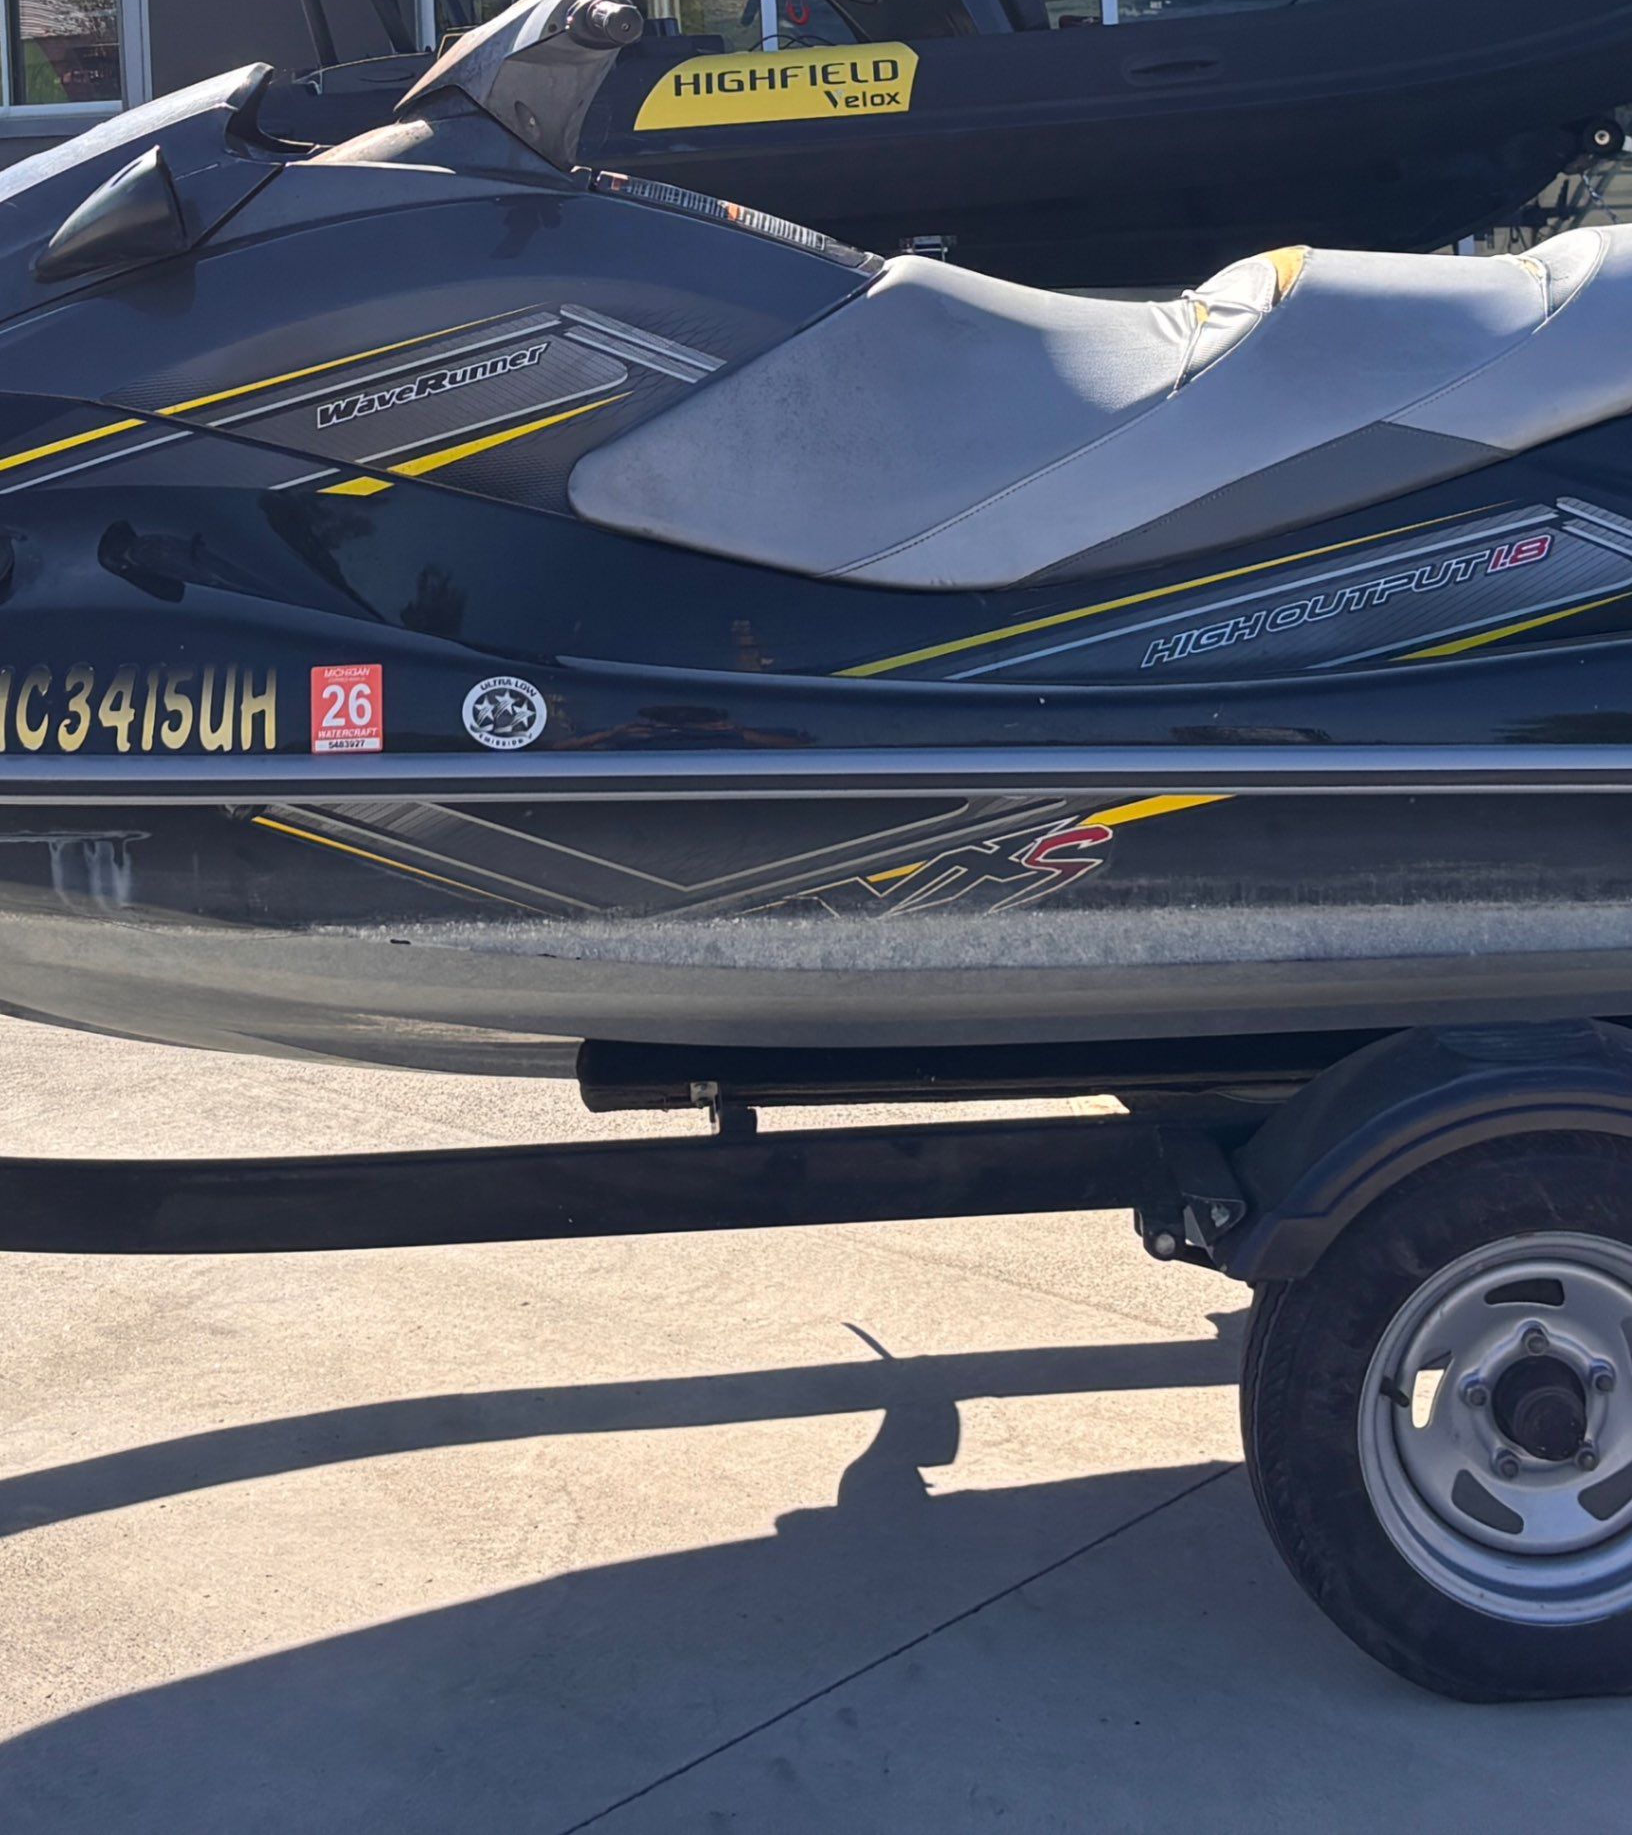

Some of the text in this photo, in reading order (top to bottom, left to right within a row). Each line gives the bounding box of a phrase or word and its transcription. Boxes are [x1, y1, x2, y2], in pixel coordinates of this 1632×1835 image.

[673, 58, 900, 97] HIGHFIELD
[823, 90, 901, 109] Velox
[318, 342, 550, 429] WaveRunner
[1141, 533, 1555, 669] HIGH OUTPUT 1.8
[321, 683, 373, 727] 26
[480, 678, 537, 697] ULTRA LOW
[318, 727, 378, 739] WATERCRAFT
